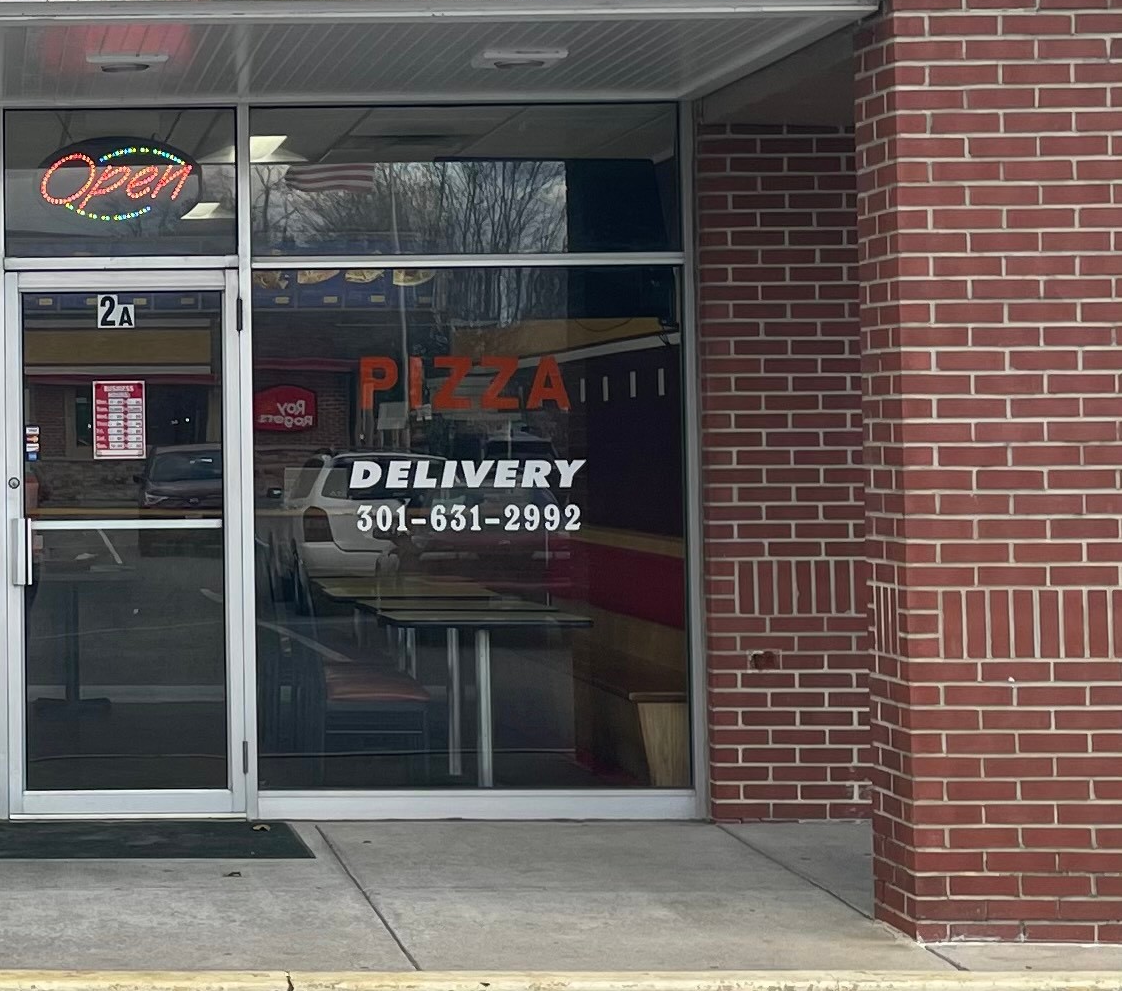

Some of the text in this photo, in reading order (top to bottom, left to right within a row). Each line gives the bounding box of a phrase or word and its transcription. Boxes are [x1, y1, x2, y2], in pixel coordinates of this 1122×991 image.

[39, 151, 193, 210] Open
[359, 355, 572, 411] PIZZA
[349, 459, 586, 489] DELIVERY
[356, 504, 582, 532] 301-631-2992
